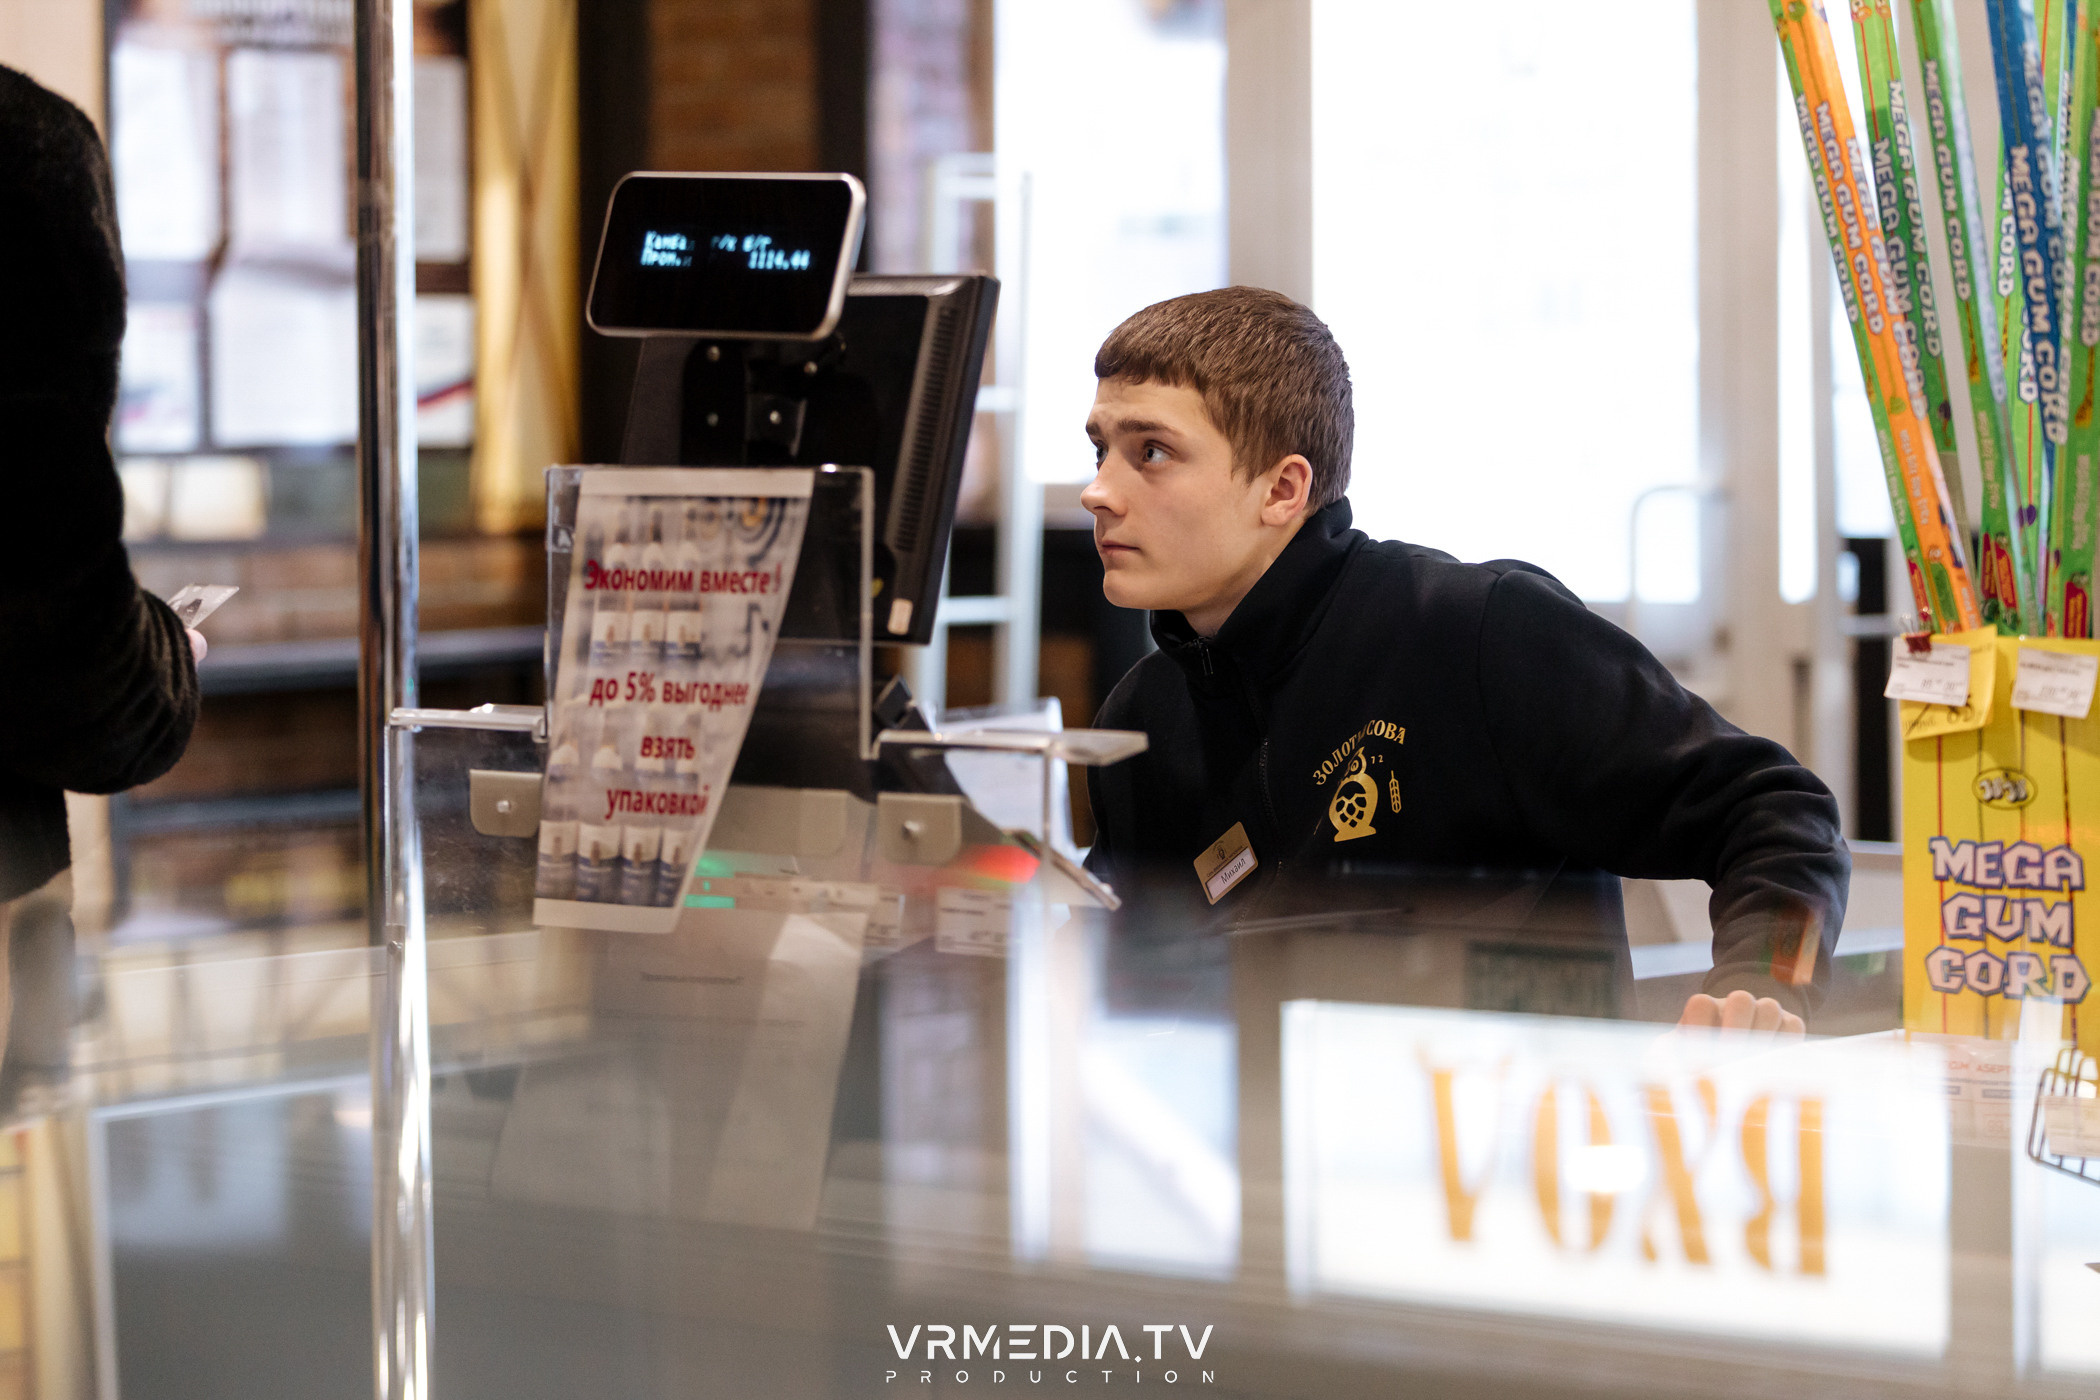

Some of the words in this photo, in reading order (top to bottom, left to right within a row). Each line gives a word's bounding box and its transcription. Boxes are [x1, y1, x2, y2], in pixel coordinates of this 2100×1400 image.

[1924, 60, 1947, 140] MEGA
[1797, 93, 1821, 171] MEGA
[1815, 174, 1839, 239] GUM
[1832, 242, 1859, 322] CORD
[1873, 136, 1900, 233] MEGA
[1937, 143, 1958, 211] GUM
[2011, 144, 2039, 245] MEGA
[1816, 100, 1845, 181] MEGA
[1835, 183, 1862, 249] GUM
[1854, 252, 1885, 335] CORD
[1889, 79, 1914, 171] MEGA
[1902, 176, 1927, 254] GUM
[1915, 261, 1941, 358] CORD
[1998, 215, 2016, 298] CORD
[1886, 235, 1913, 314] GUM
[1947, 217, 1971, 301] CORD
[2022, 248, 2051, 334] GUM
[584, 558, 695, 591] Экономим
[588, 677, 619, 708] до
[625, 670, 656, 704] 5%
[640, 735, 696, 760] взять
[1366, 719, 1406, 745] СОВА
[1221, 858, 1246, 885] Михаил
[1928, 836, 2085, 891] MEGA
[1941, 891, 2075, 948] GUM
[1925, 945, 2092, 1005] CORD
